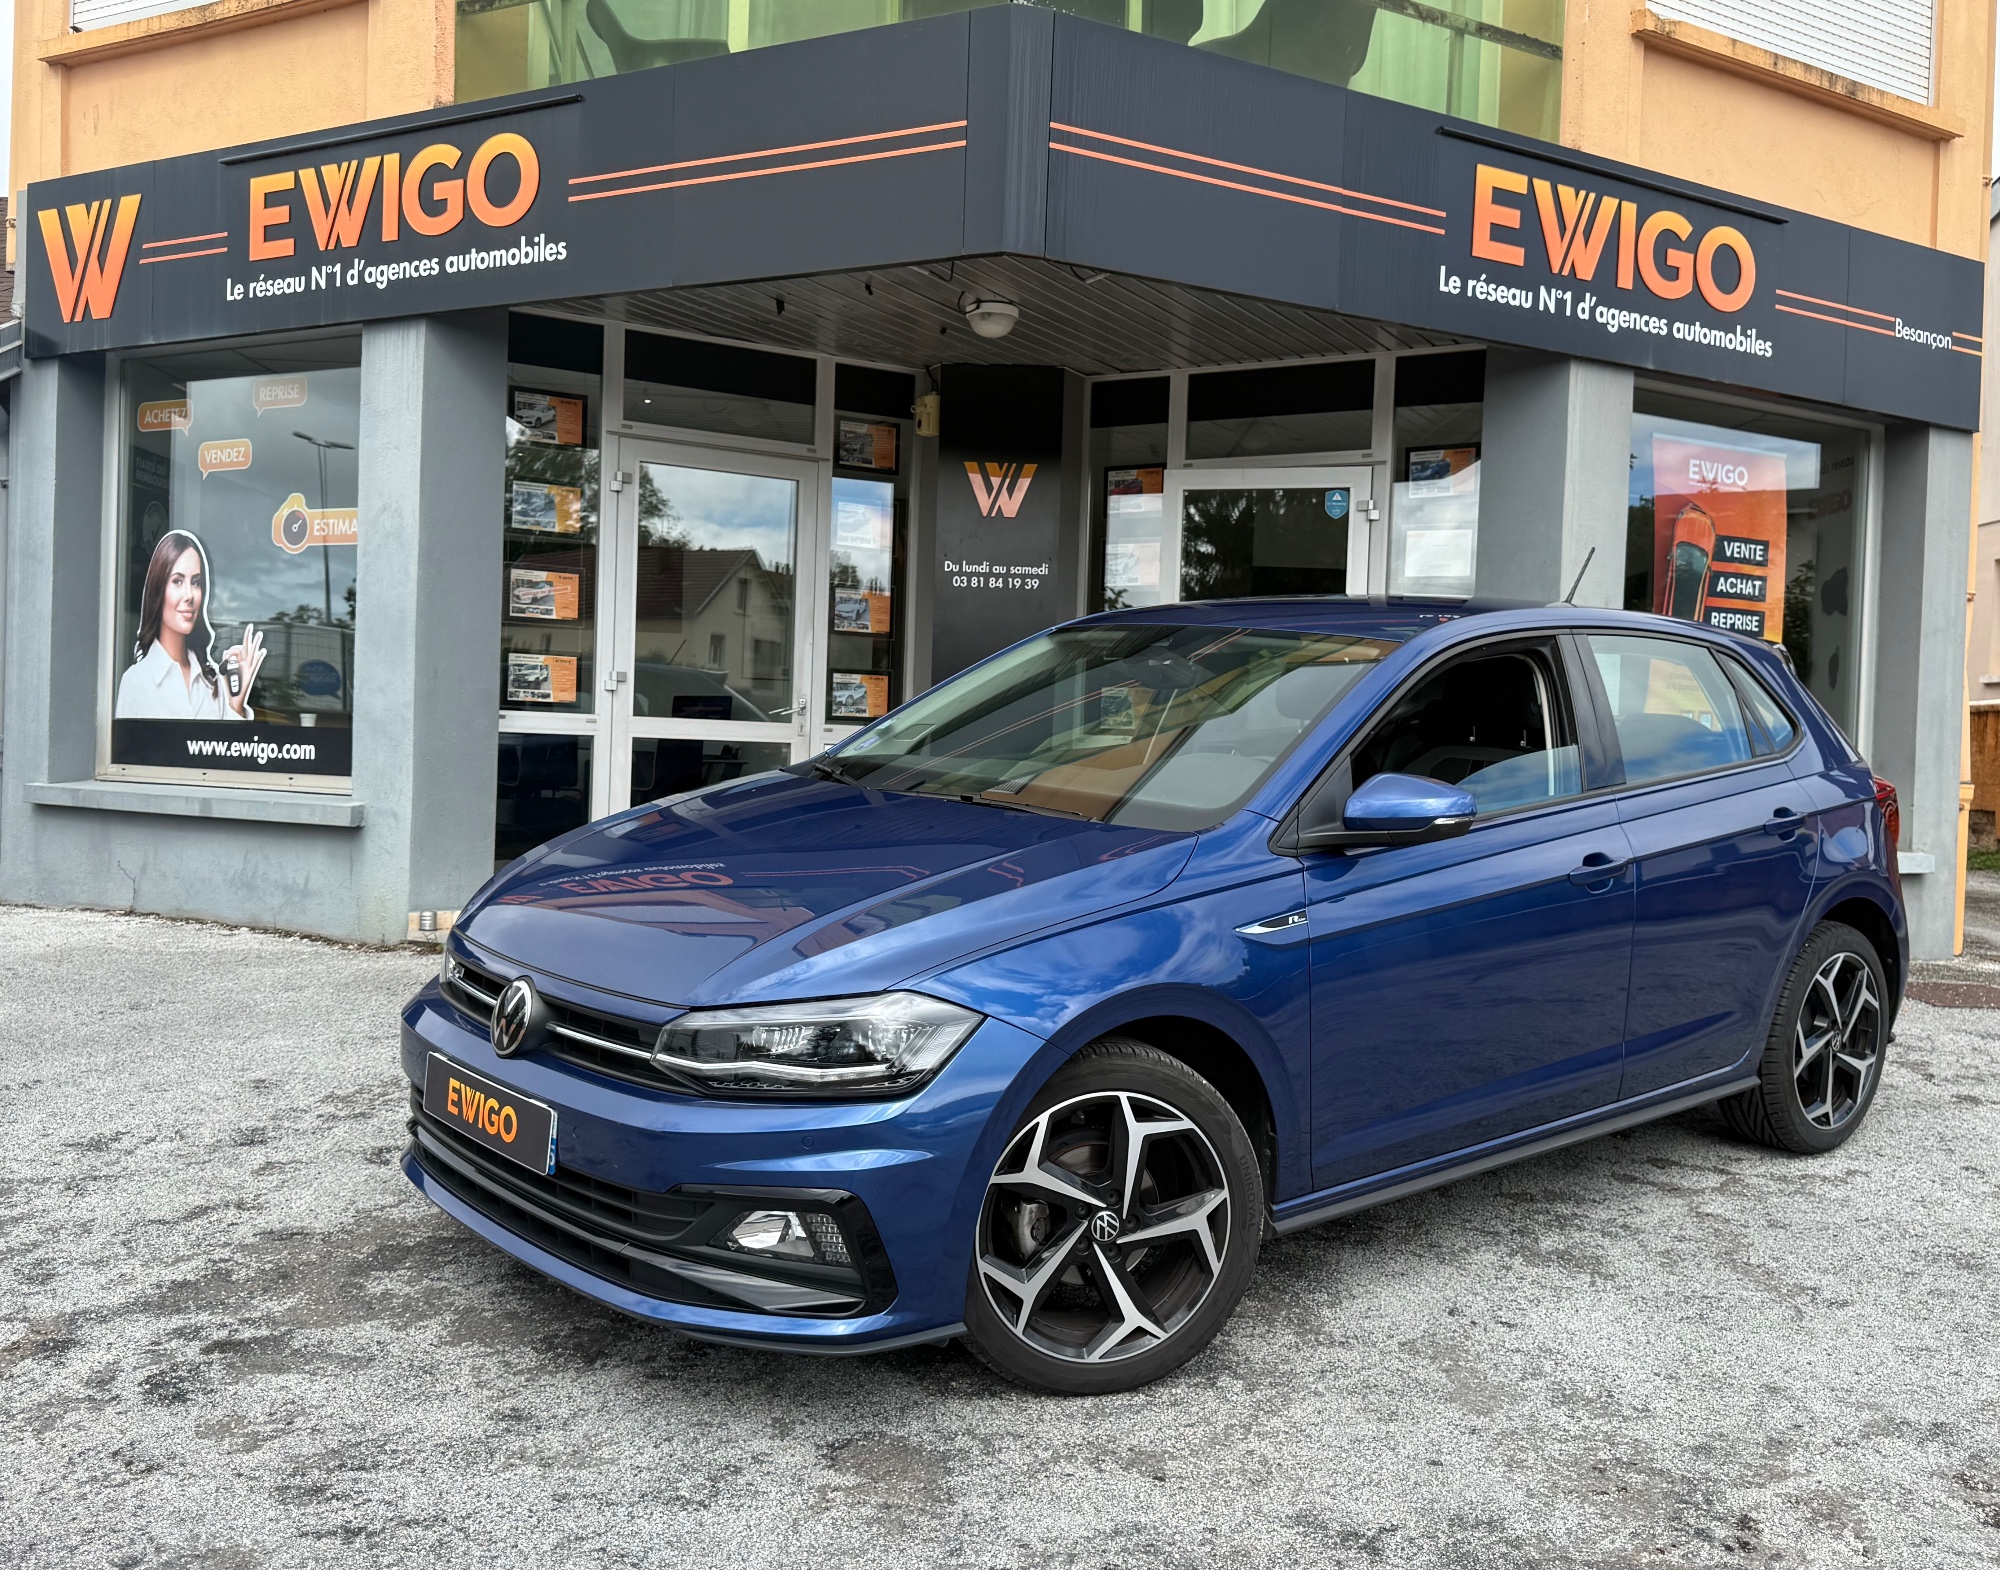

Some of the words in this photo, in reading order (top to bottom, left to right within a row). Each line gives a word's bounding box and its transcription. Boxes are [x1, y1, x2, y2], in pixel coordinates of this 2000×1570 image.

[249, 132, 539, 262] EWIGO
[1471, 163, 1756, 313] EWIGO
[226, 278, 244, 301] Le
[249, 273, 305, 299] réseau
[347, 258, 439, 290] d'agences
[445, 233, 567, 274] automobiles
[1439, 265, 1461, 294] Le
[1467, 273, 1532, 309] réseau
[1577, 292, 1668, 336] d'agences
[1672, 320, 1773, 358] automobiles
[1895, 318, 1952, 352] Besançon
[259, 384, 299, 401] REPRISE
[144, 407, 187, 424] ACHETEZ
[204, 447, 245, 464] VENDEZ
[1688, 459, 1748, 486] EWIGO
[1724, 541, 1764, 561] VENTE
[944, 560, 959, 572] Du
[962, 560, 989, 573] lundi
[992, 565, 1006, 574] au
[1010, 563, 1049, 575] samedi
[952, 576, 967, 587] 03
[971, 576, 984, 587] 81
[989, 577, 1003, 588] 84
[1008, 577, 1021, 589] 19
[1024, 578, 1039, 590] 39
[1716, 577, 1762, 596] ACHAT
[1711, 612, 1760, 632] REPRISE
[187, 736, 315, 764] www.ewigo.com
[447, 1077, 518, 1143] EWIGO
[1239, 1155, 1257, 1233] UNIROYAL
